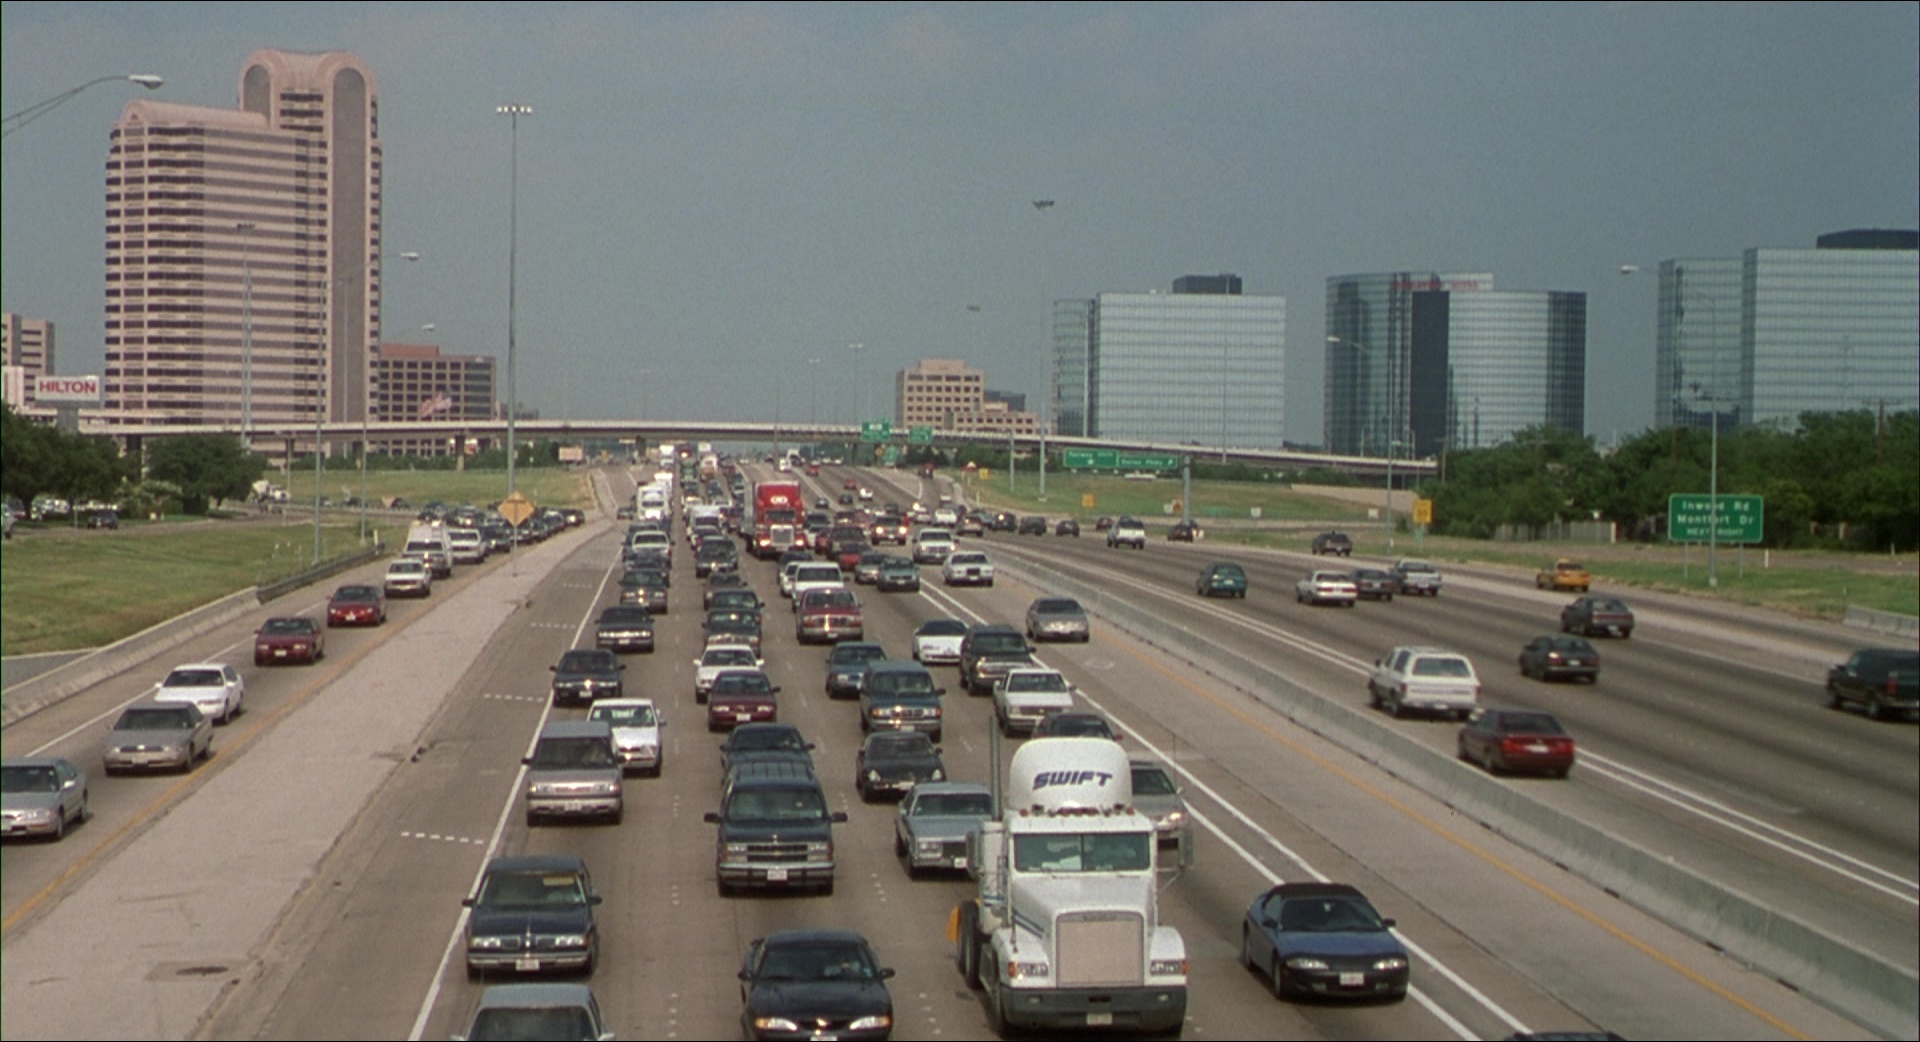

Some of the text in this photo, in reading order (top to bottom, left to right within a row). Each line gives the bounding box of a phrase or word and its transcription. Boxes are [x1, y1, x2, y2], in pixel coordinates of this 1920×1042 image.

[39, 381, 96, 393] HILTON
[1682, 500, 1750, 511] Inwod Rd
[1739, 514, 1754, 525] Dr
[1033, 770, 1112, 790] SWIFT
